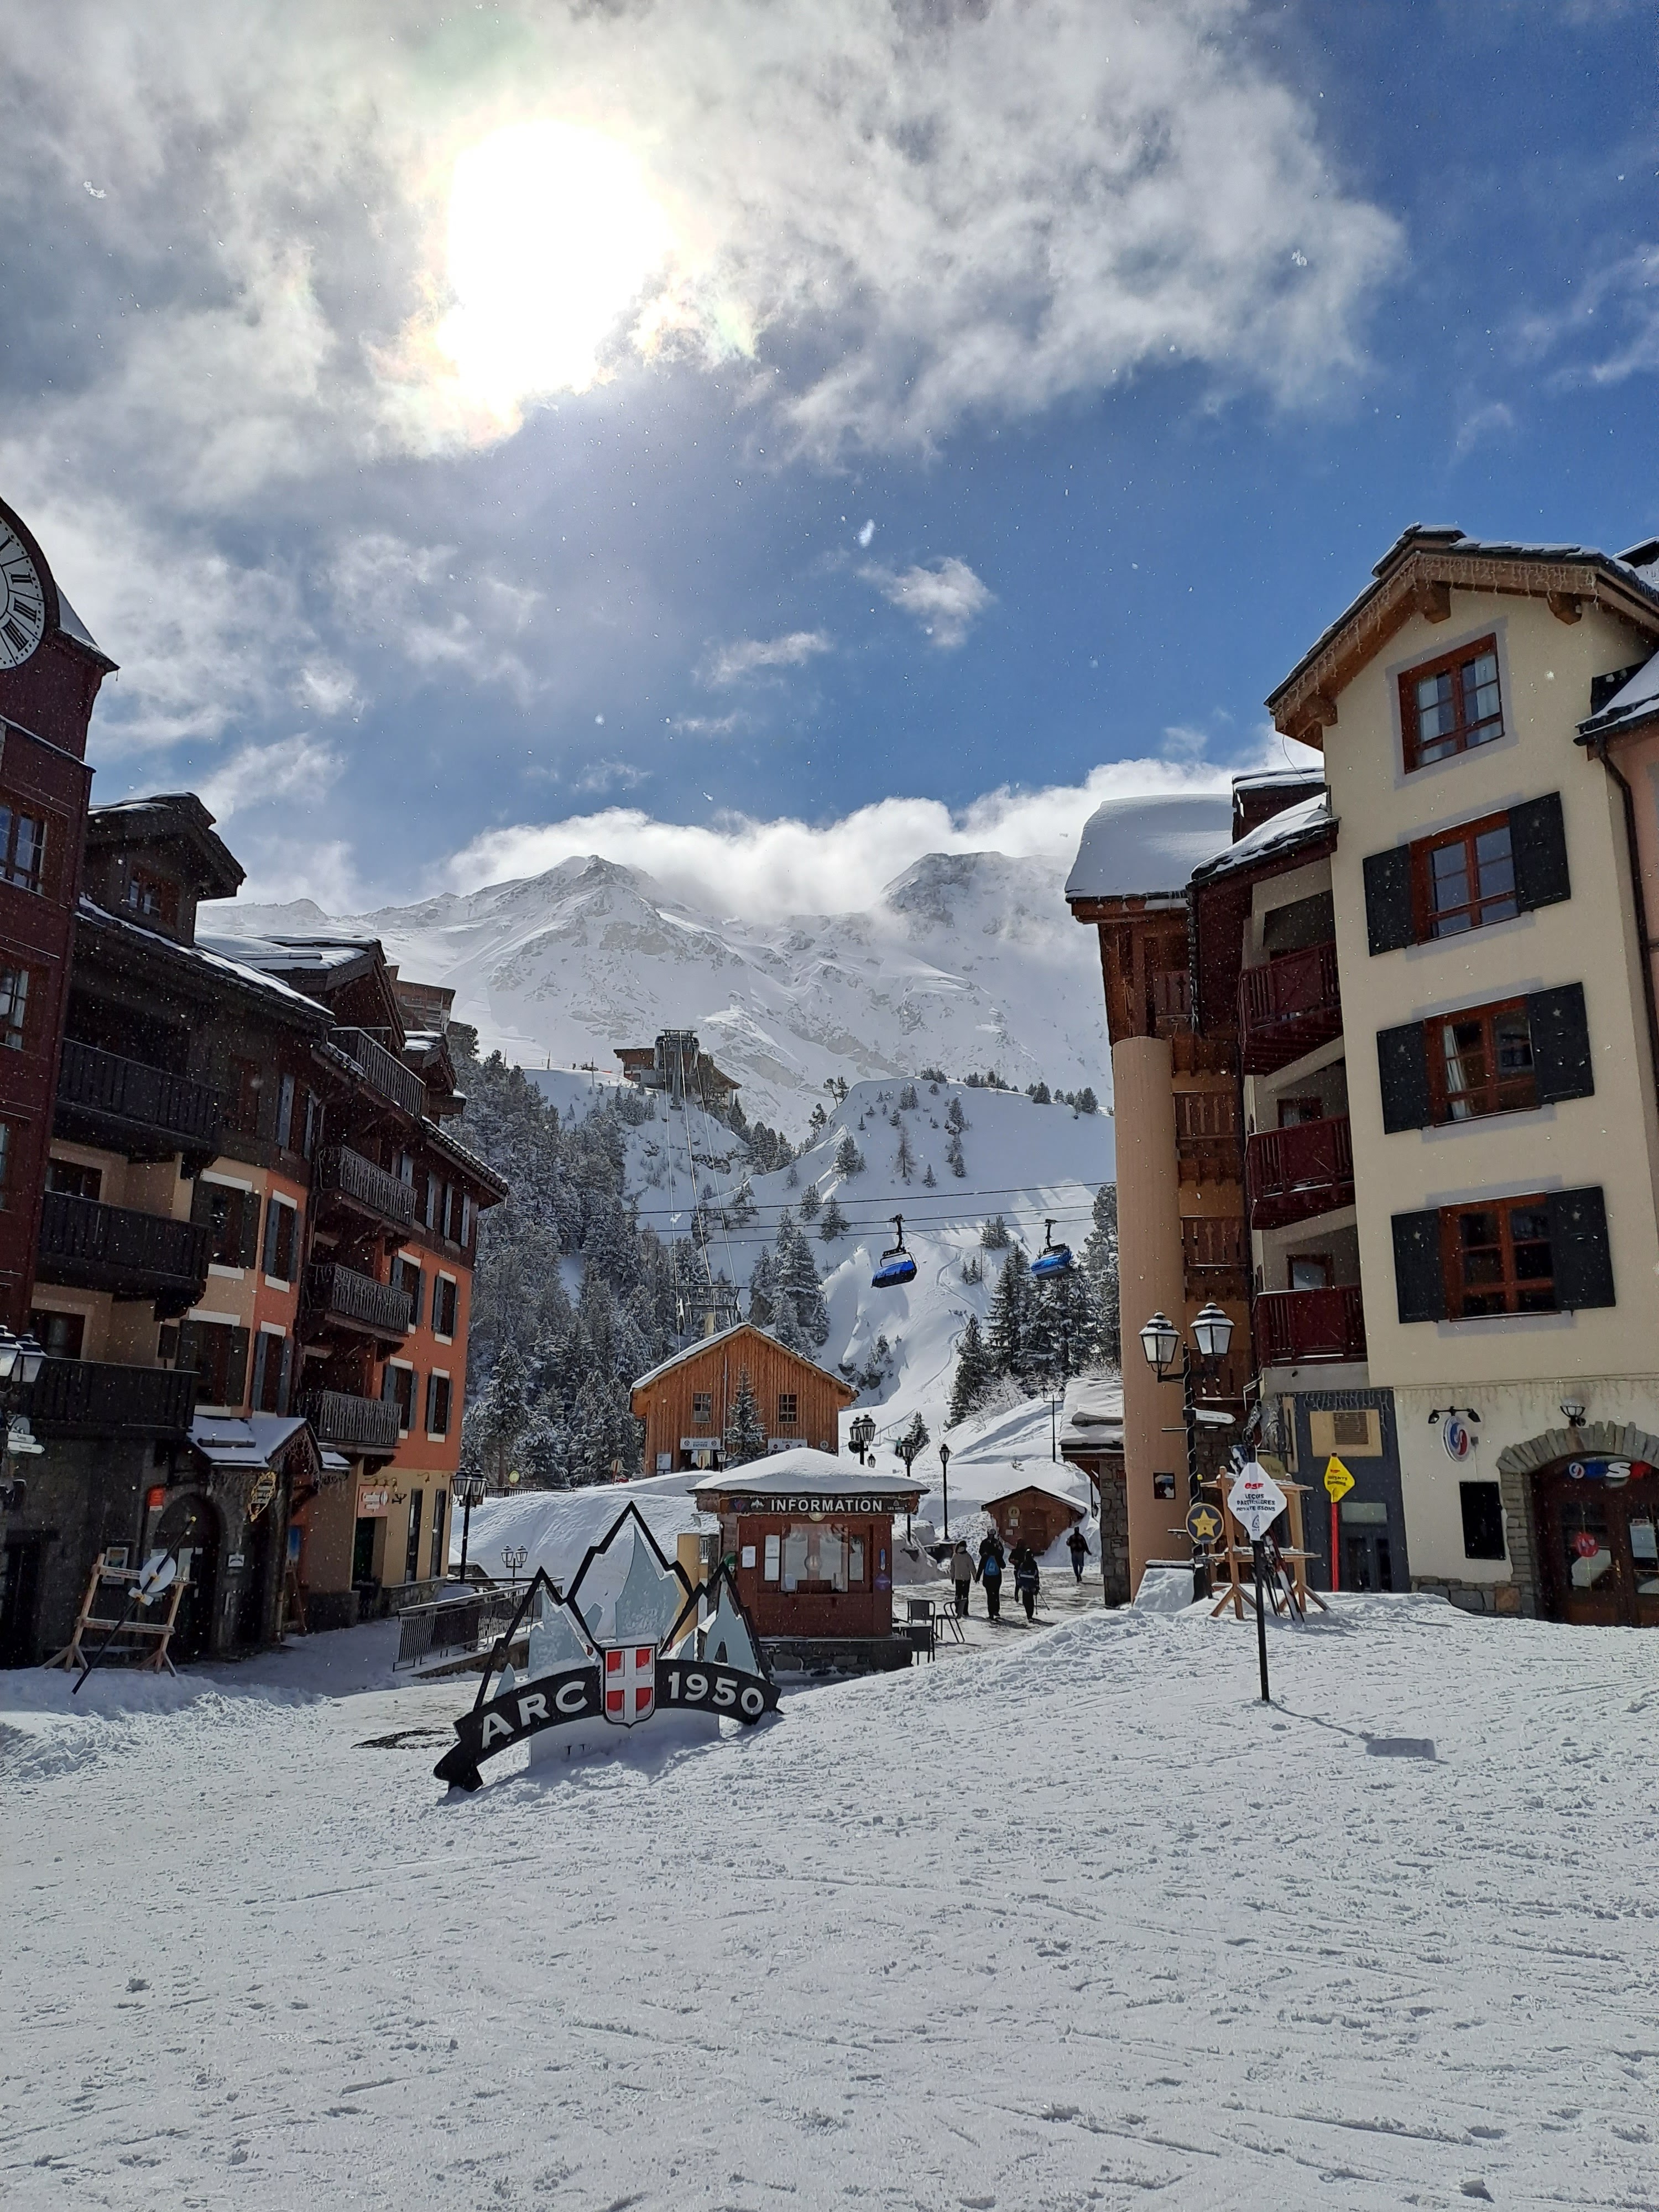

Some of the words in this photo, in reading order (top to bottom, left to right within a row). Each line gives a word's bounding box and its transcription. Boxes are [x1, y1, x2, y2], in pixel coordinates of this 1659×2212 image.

[771, 1499, 883, 1512] INFORMATION
[482, 1681, 588, 1749] ARC
[668, 1671, 764, 1715] 1950
